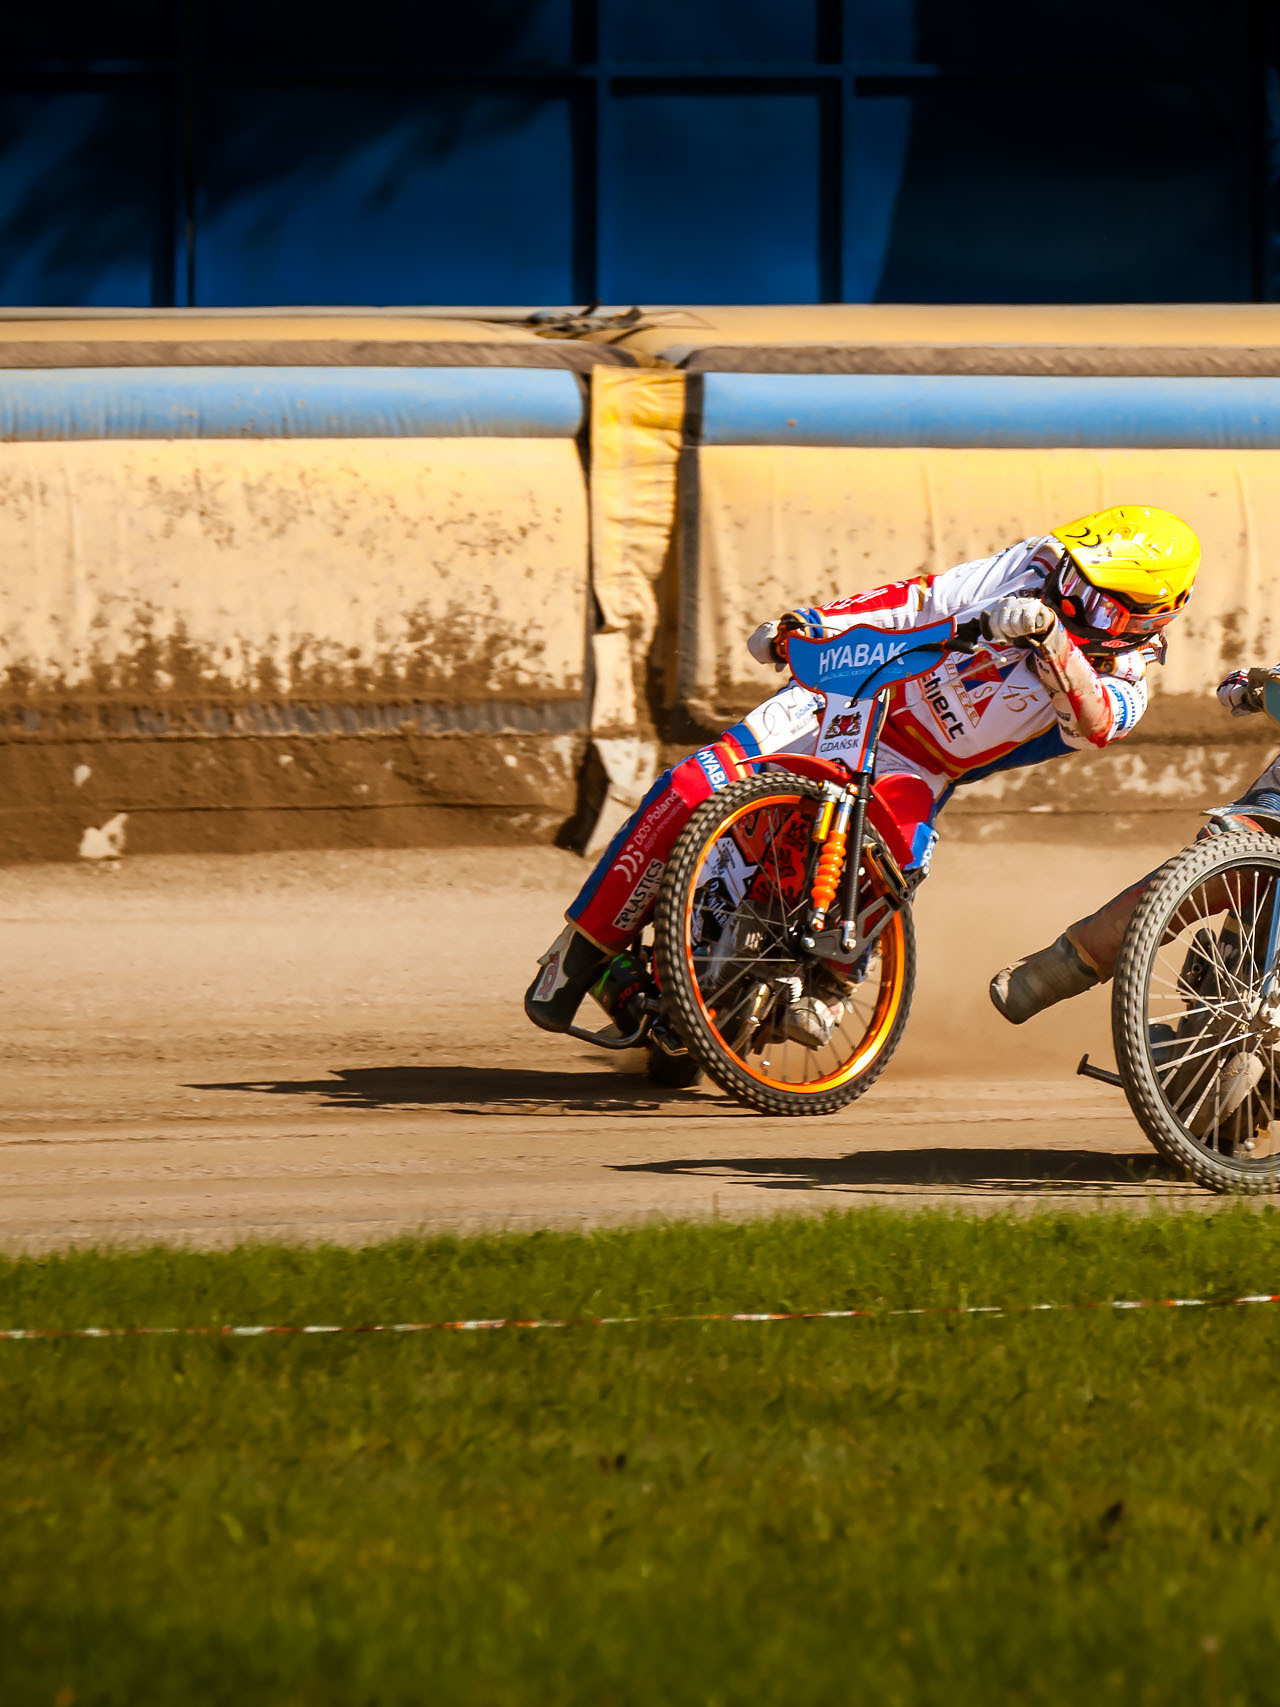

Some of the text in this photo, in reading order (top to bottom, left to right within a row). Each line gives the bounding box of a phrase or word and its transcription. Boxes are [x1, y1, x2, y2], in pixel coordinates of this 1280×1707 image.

[819, 642, 907, 675] HYABAK
[1001, 685, 1040, 713] 45
[647, 788, 679, 823] Poland
